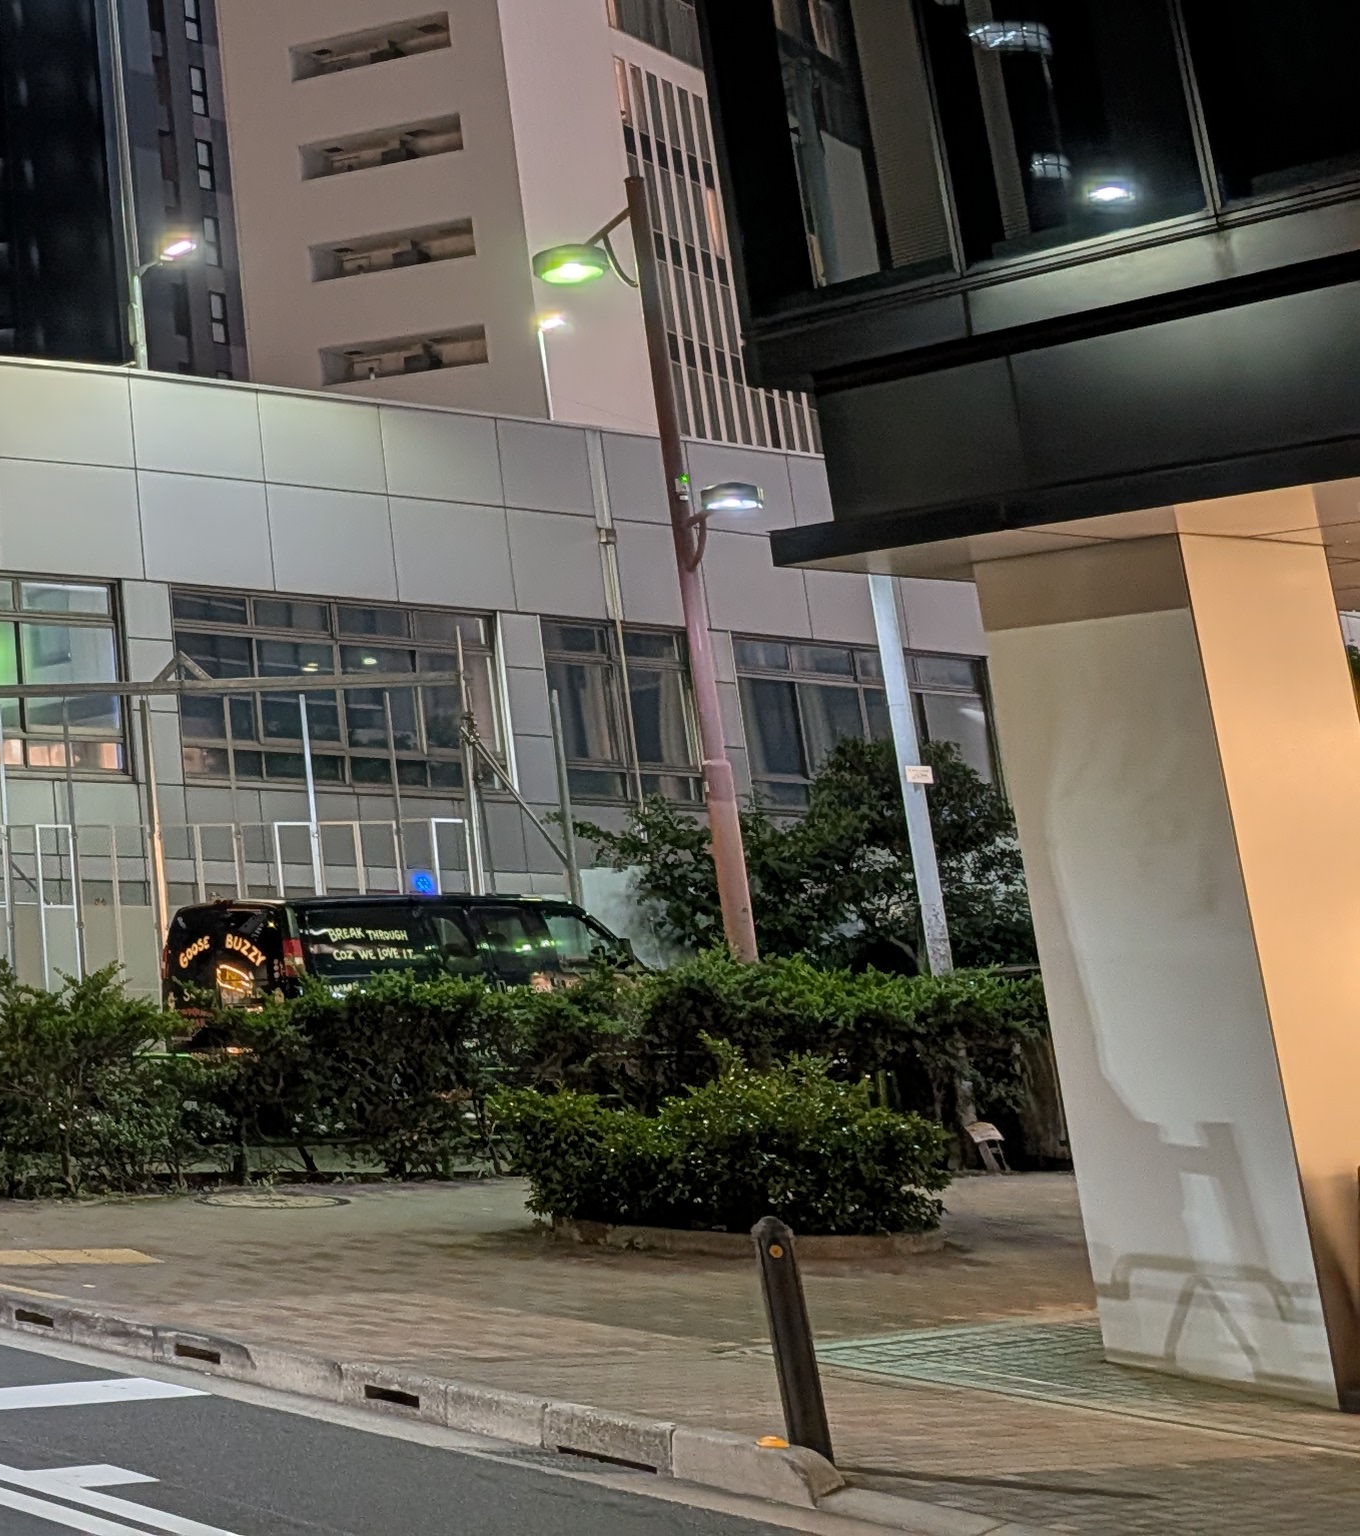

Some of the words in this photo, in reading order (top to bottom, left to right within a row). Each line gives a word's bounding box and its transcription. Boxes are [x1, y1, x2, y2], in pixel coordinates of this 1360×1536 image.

[327, 927, 365, 943] BREAK
[365, 929, 409, 941] THROUGH
[179, 935, 211, 969] GOOSE
[224, 933, 267, 967] BUZZY
[332, 949, 356, 961] COZ
[357, 948, 376, 960] WE
[376, 946, 401, 961] LOVE
